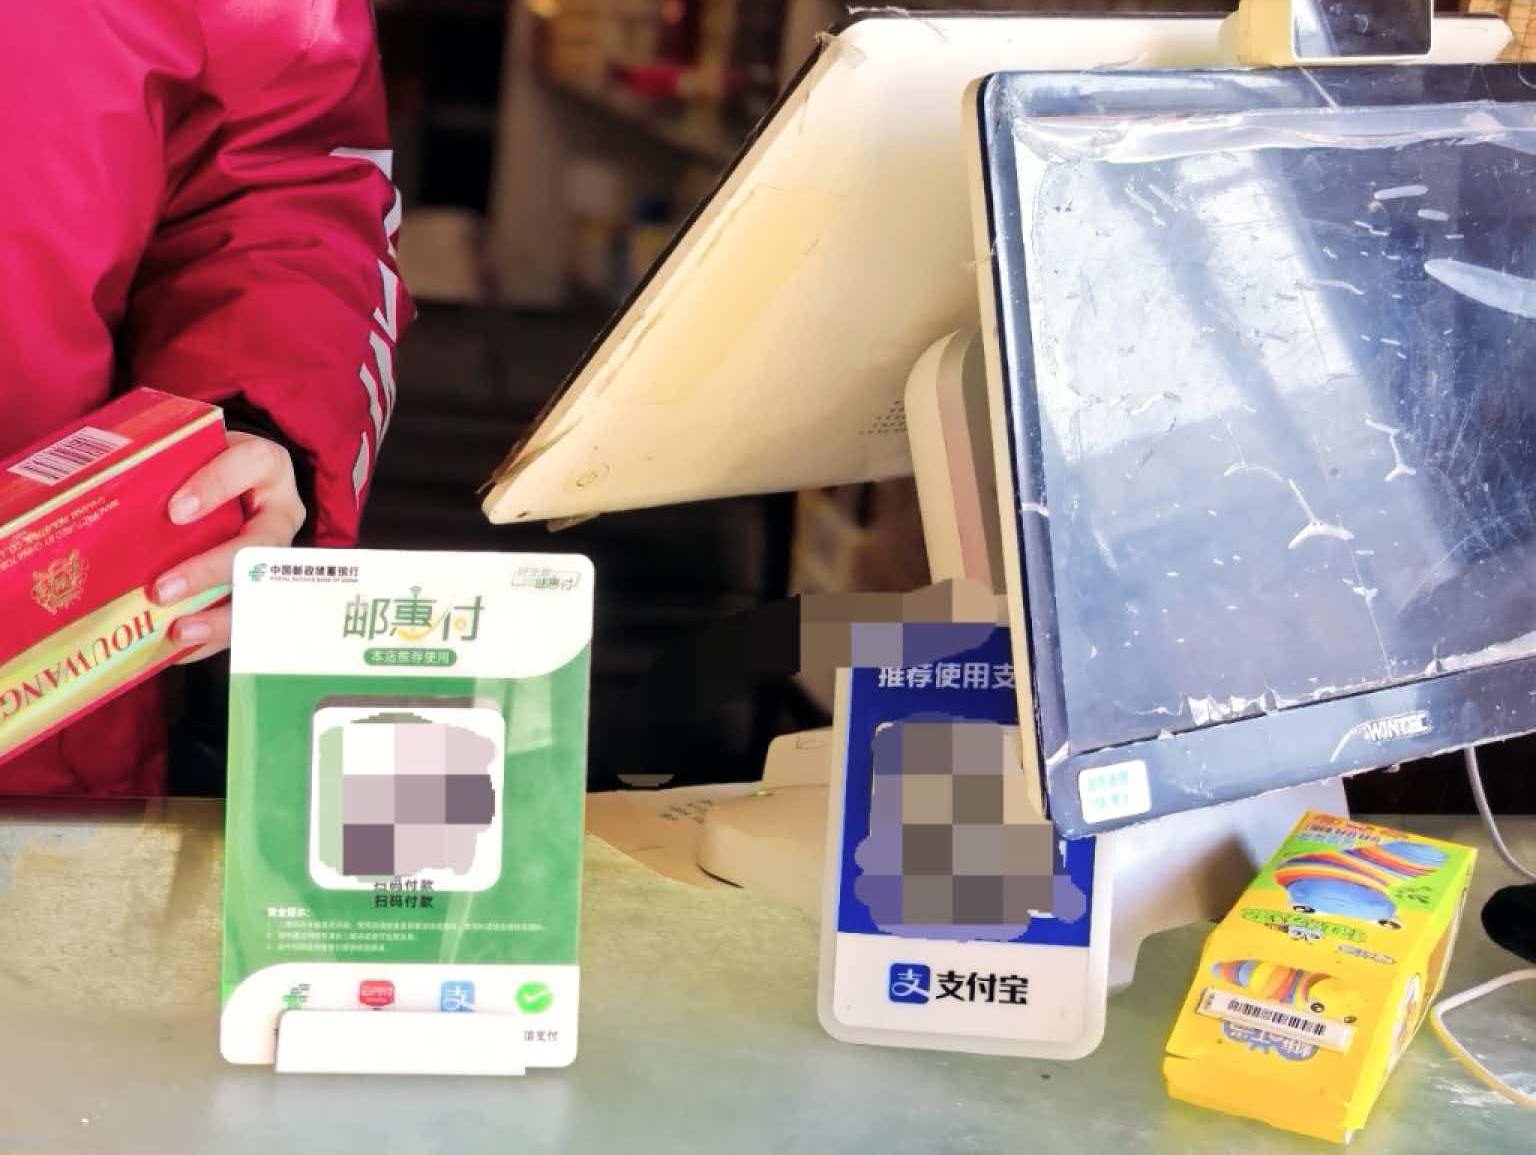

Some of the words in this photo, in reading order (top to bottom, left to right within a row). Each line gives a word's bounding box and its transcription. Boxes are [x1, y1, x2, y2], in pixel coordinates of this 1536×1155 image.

[270, 563, 359, 577] 中国邮政储蓄银行
[0, 610, 155, 718] HOUWANG
[373, 894, 434, 909] 扫码付款
[936, 970, 1029, 1006] 支付宝
